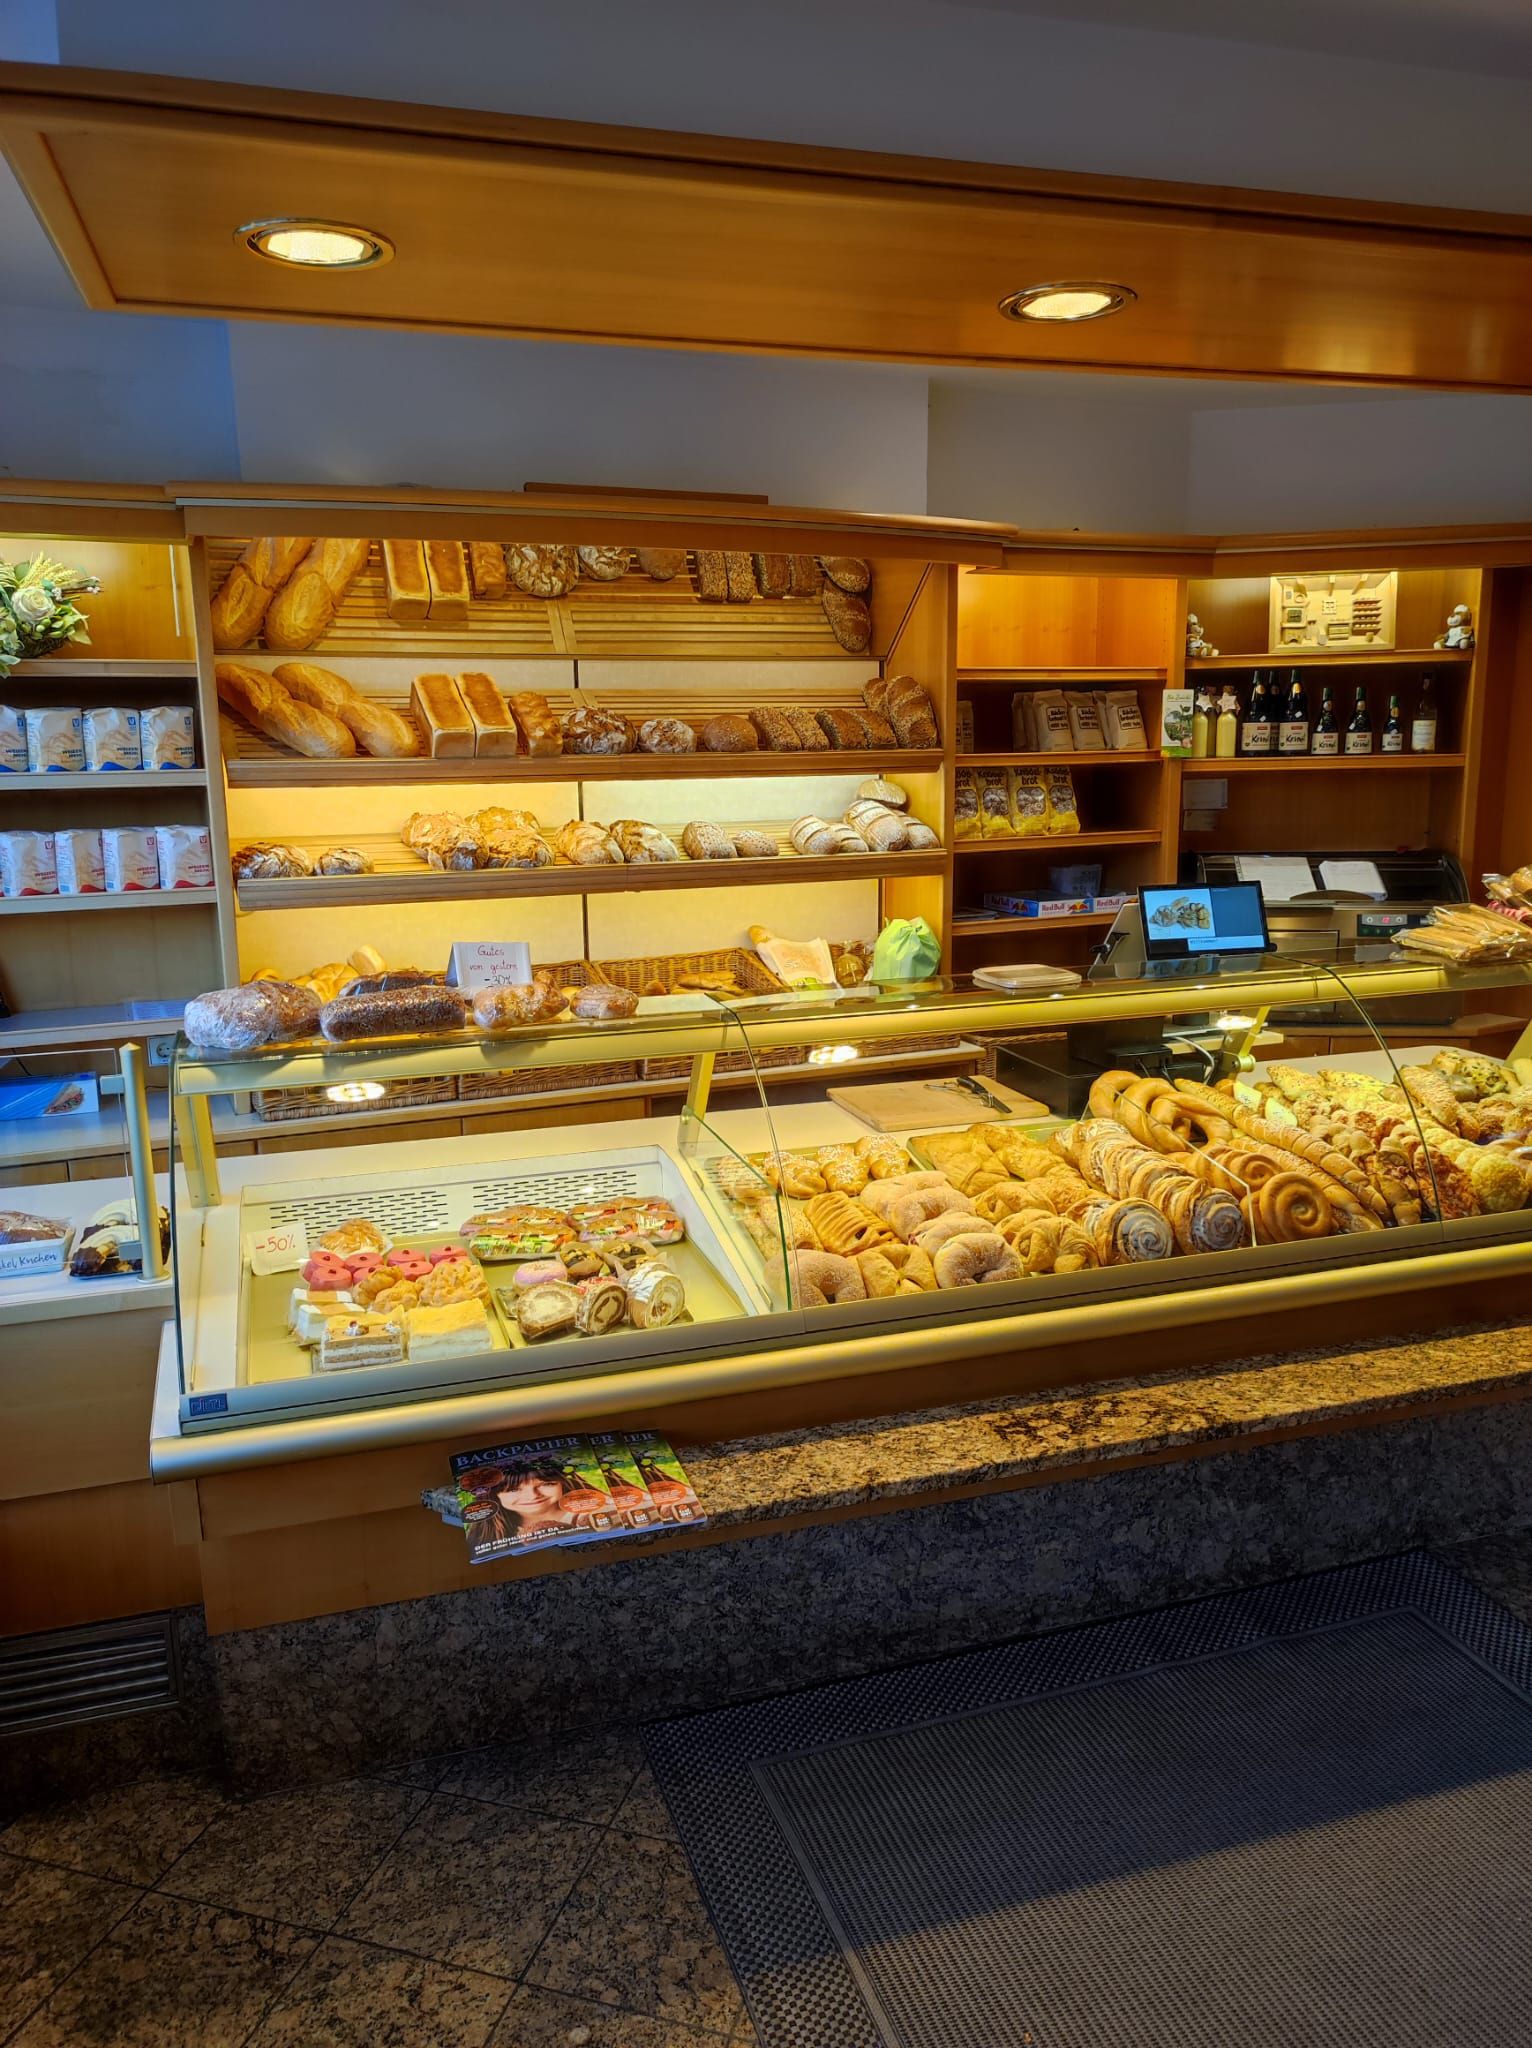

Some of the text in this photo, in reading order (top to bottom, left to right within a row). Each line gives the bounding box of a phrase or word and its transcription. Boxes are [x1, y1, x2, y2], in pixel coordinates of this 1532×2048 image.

[478, 944, 504, 956] Gutes
[490, 960, 518, 975] gestern
[256, 1234, 296, 1252] -50%
[19, 1252, 56, 1266] Kuchen
[456, 1436, 580, 1467] BACKPAPIER
[474, 1542, 491, 1551] DER
[492, 1532, 532, 1546] FRÜHLING
